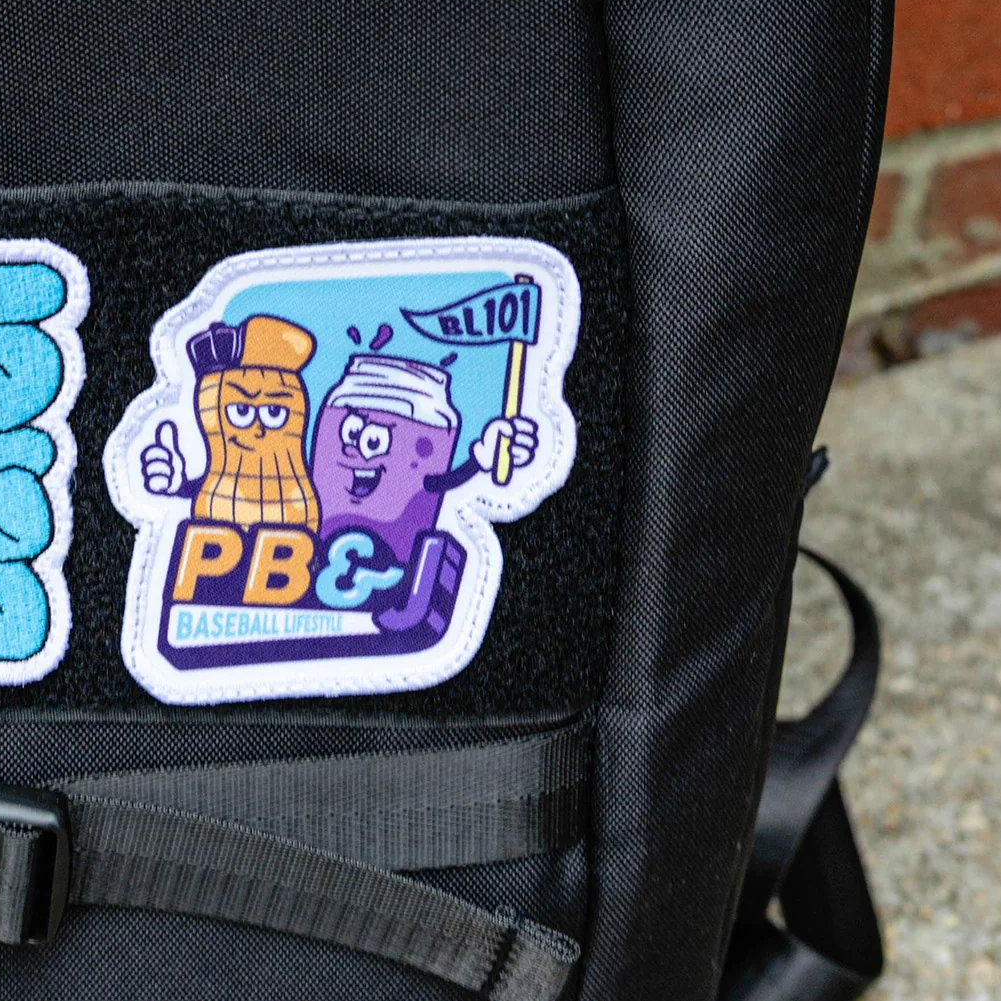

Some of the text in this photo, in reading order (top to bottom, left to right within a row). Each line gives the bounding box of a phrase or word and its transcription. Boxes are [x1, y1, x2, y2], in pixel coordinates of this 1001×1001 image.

[437, 288, 531, 337] BL101
[172, 524, 446, 632] PB&J
[175, 604, 343, 641] BASEBALL LIFESTYLE
